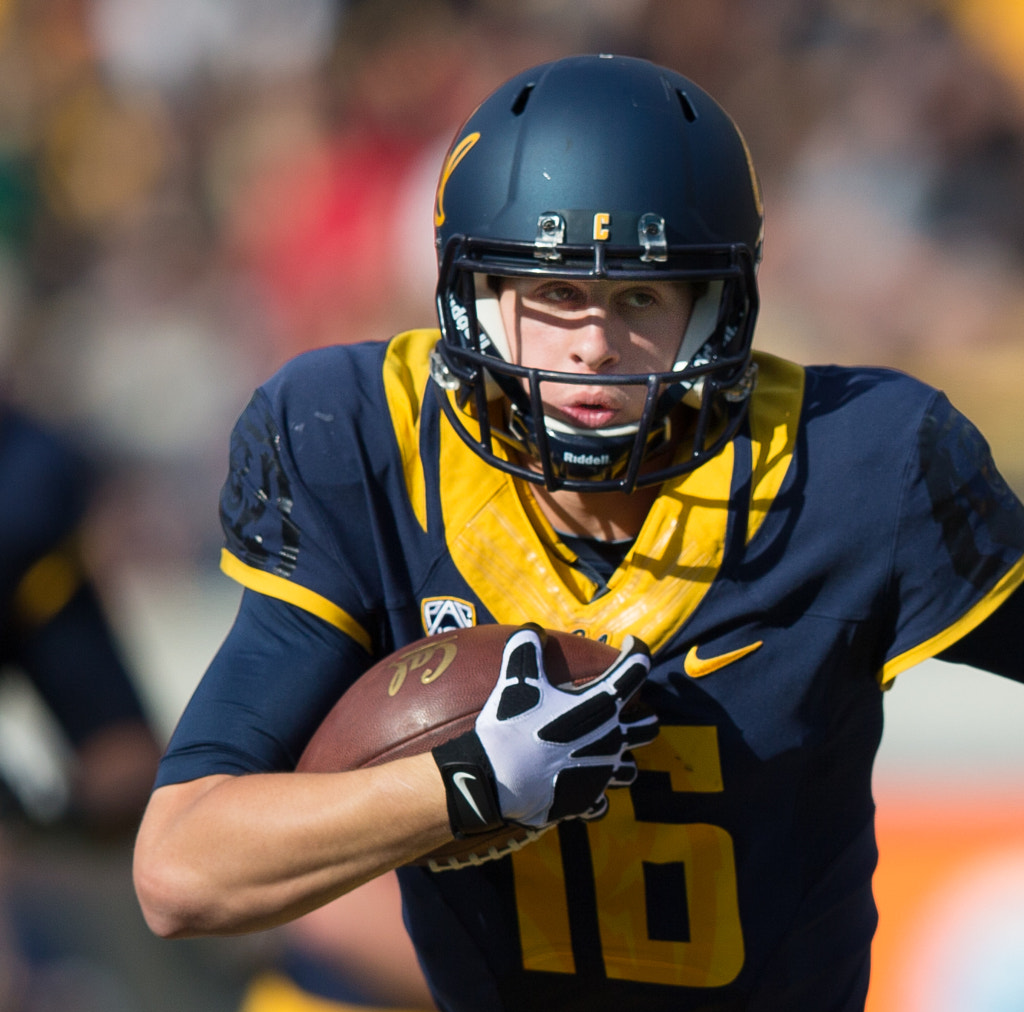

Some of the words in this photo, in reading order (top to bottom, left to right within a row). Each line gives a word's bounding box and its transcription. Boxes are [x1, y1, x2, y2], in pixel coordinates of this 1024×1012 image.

[593, 212, 610, 240] C
[563, 451, 610, 465] Riddell
[388, 638, 458, 697] Cal
[511, 725, 745, 988] 16
